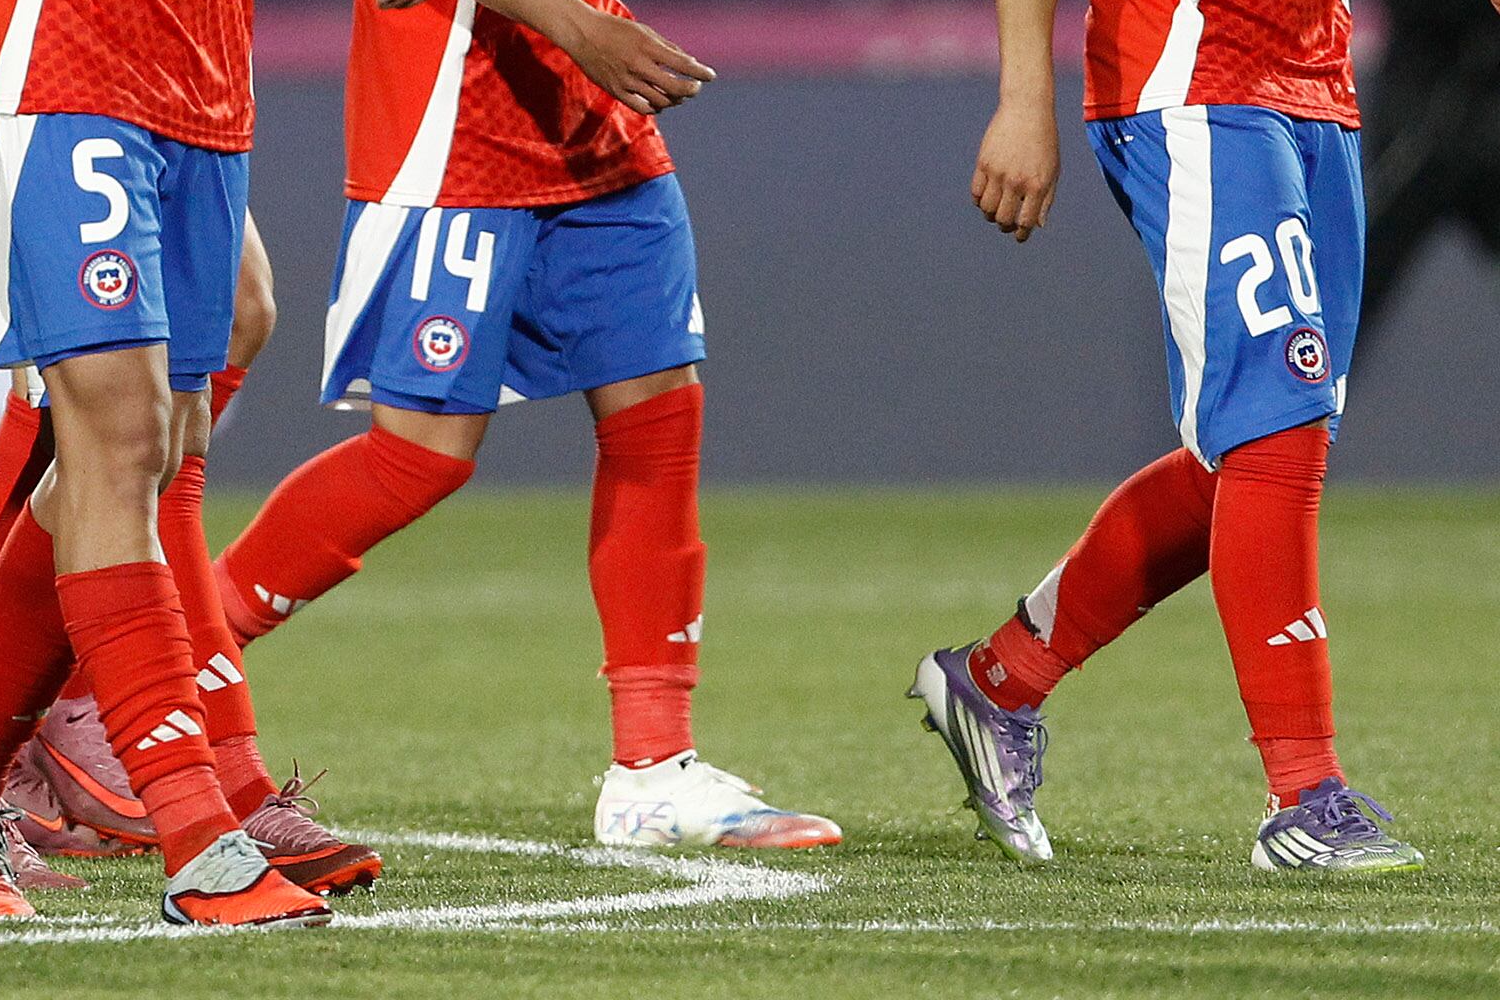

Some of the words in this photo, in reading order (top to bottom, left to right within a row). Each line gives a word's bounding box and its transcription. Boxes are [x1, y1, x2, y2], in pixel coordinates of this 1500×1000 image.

[70, 137, 130, 244] 5
[411, 207, 496, 313] 14
[1220, 217, 1319, 337] 20
